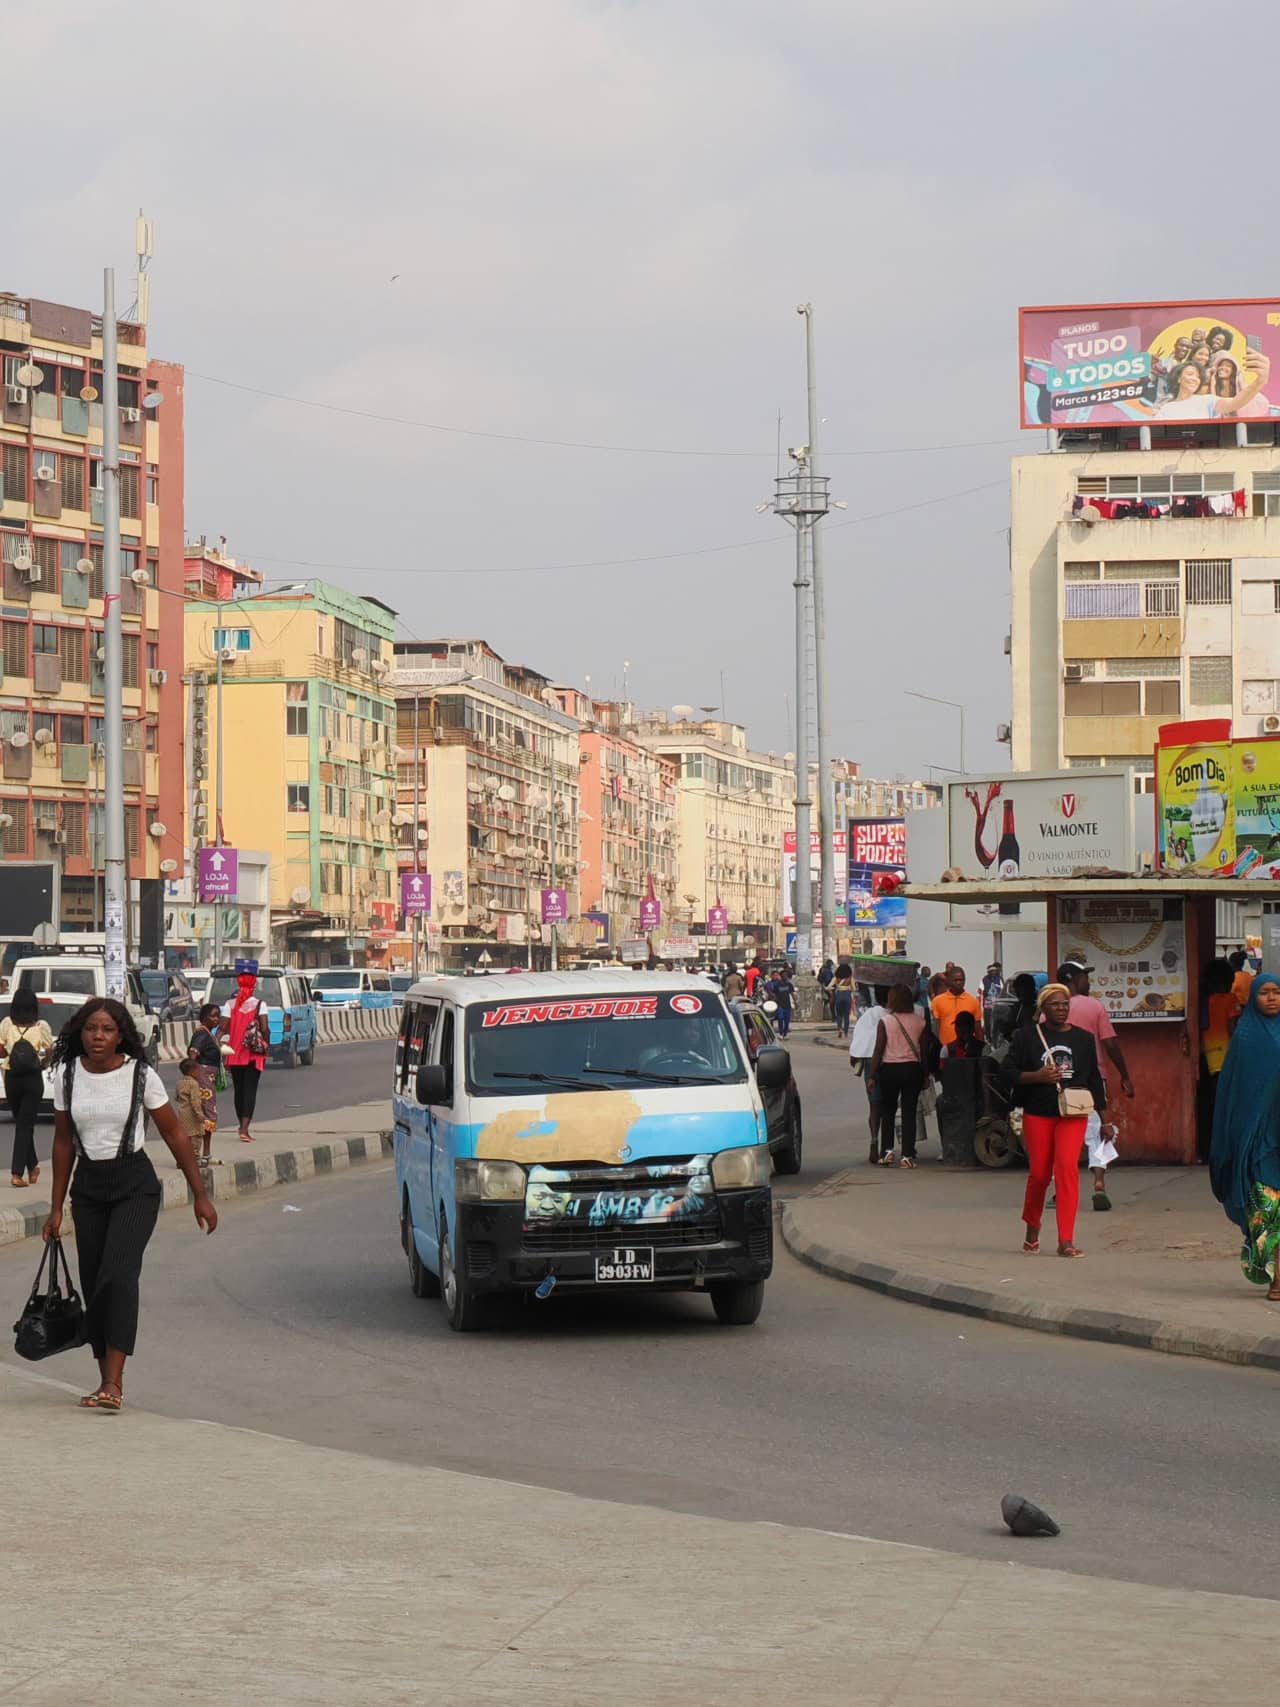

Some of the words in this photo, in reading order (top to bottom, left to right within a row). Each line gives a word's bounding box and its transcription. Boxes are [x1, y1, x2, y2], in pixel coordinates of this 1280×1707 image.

[1061, 323, 1097, 336] PLANOS
[1063, 335, 1127, 359] TUDO
[1052, 377, 1063, 387] e
[1066, 357, 1145, 385] TODOS
[1055, 395, 1088, 407] Marca
[1176, 764, 1204, 787] Bom
[1206, 758, 1225, 782] Dia
[1251, 784, 1266, 792] SUA
[1237, 808, 1268, 816] FUTUO
[857, 824, 905, 843] SUPER
[1040, 821, 1098, 838] VALMONTE
[1028, 850, 1035, 861] O
[1037, 849, 1064, 861] VINHO
[1066, 846, 1111, 860] AUTÊNTICO
[205, 873, 229, 881] LOJA
[1053, 865, 1072, 875] SABO
[482, 997, 658, 1028] VENCEDOR
